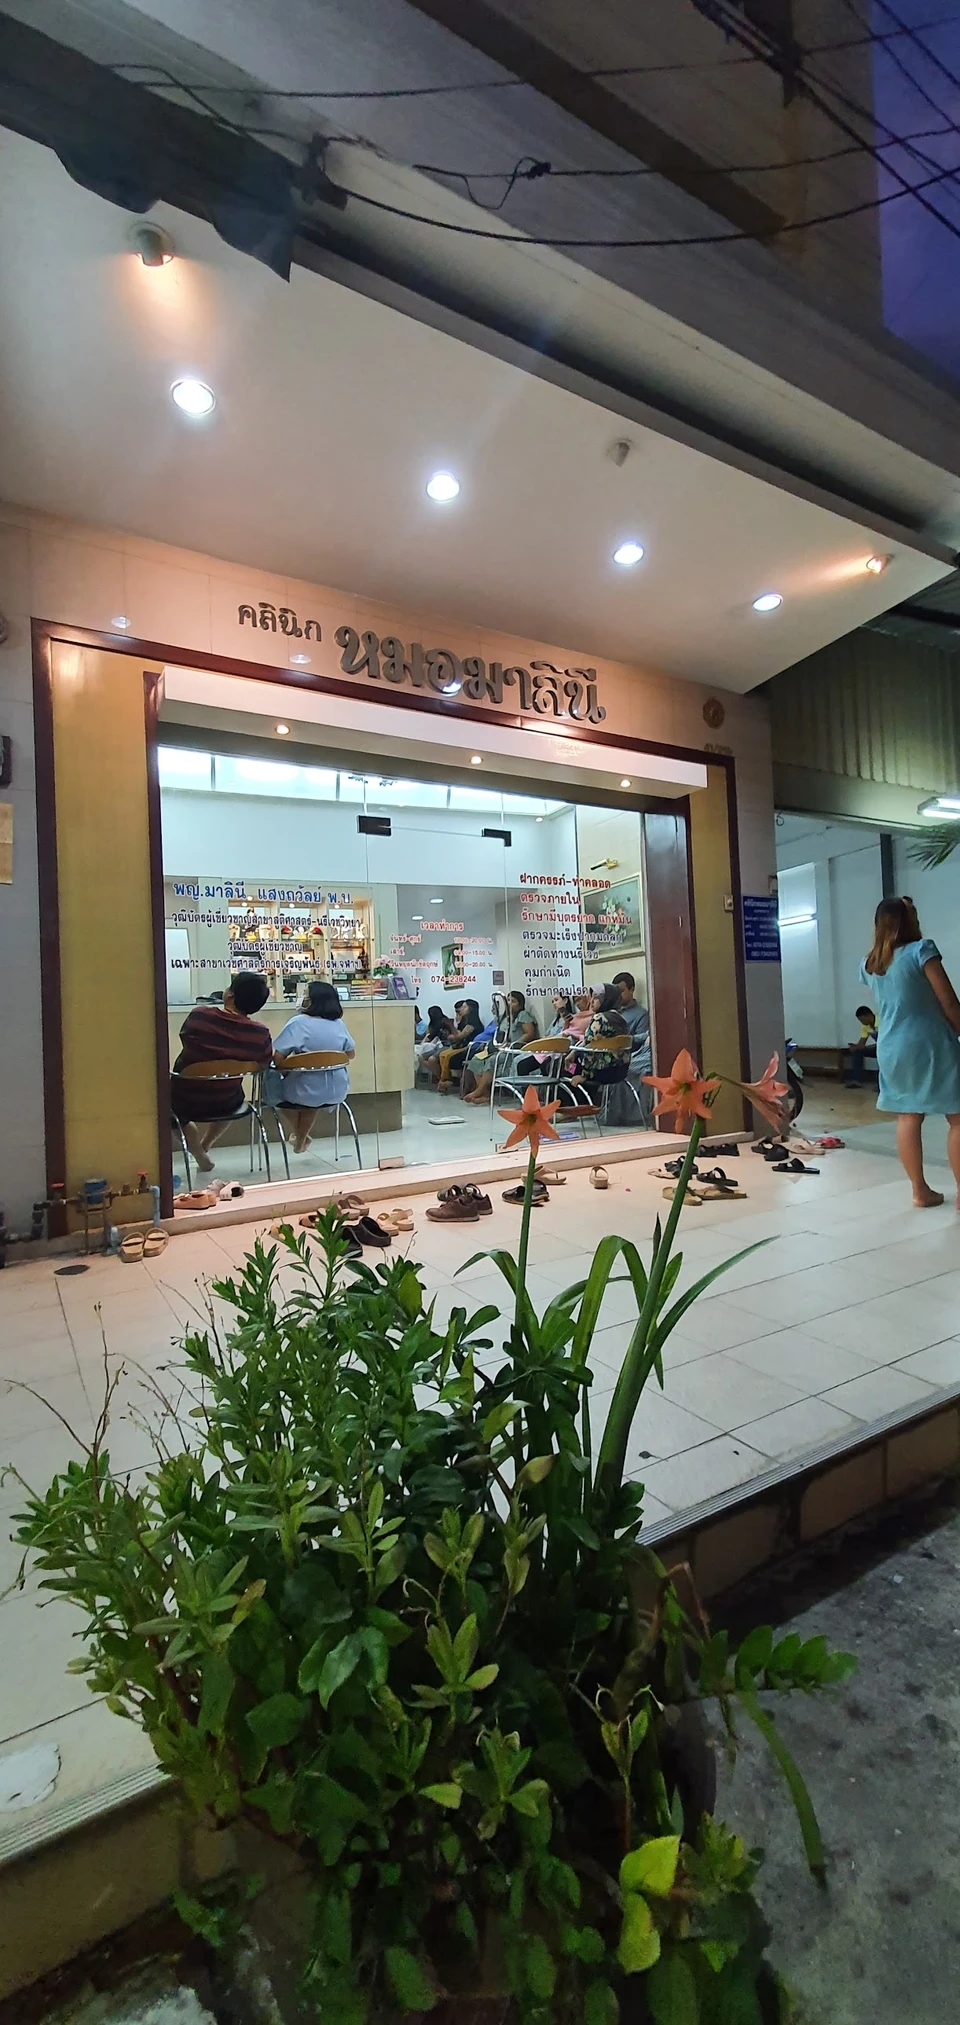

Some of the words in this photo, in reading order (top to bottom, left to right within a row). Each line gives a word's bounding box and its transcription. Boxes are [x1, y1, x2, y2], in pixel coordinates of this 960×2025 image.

[238, 601, 322, 642] คลินิก
[334, 625, 607, 724] หมอมาลินี
[173, 881, 246, 900] พญ.มาลินี
[258, 884, 321, 903] แสงถวัลย์
[520, 891, 581, 905] ตรวจภายใน
[430, 975, 477, 983] 074-238244
[524, 964, 571, 982] คุมกำเนิด
